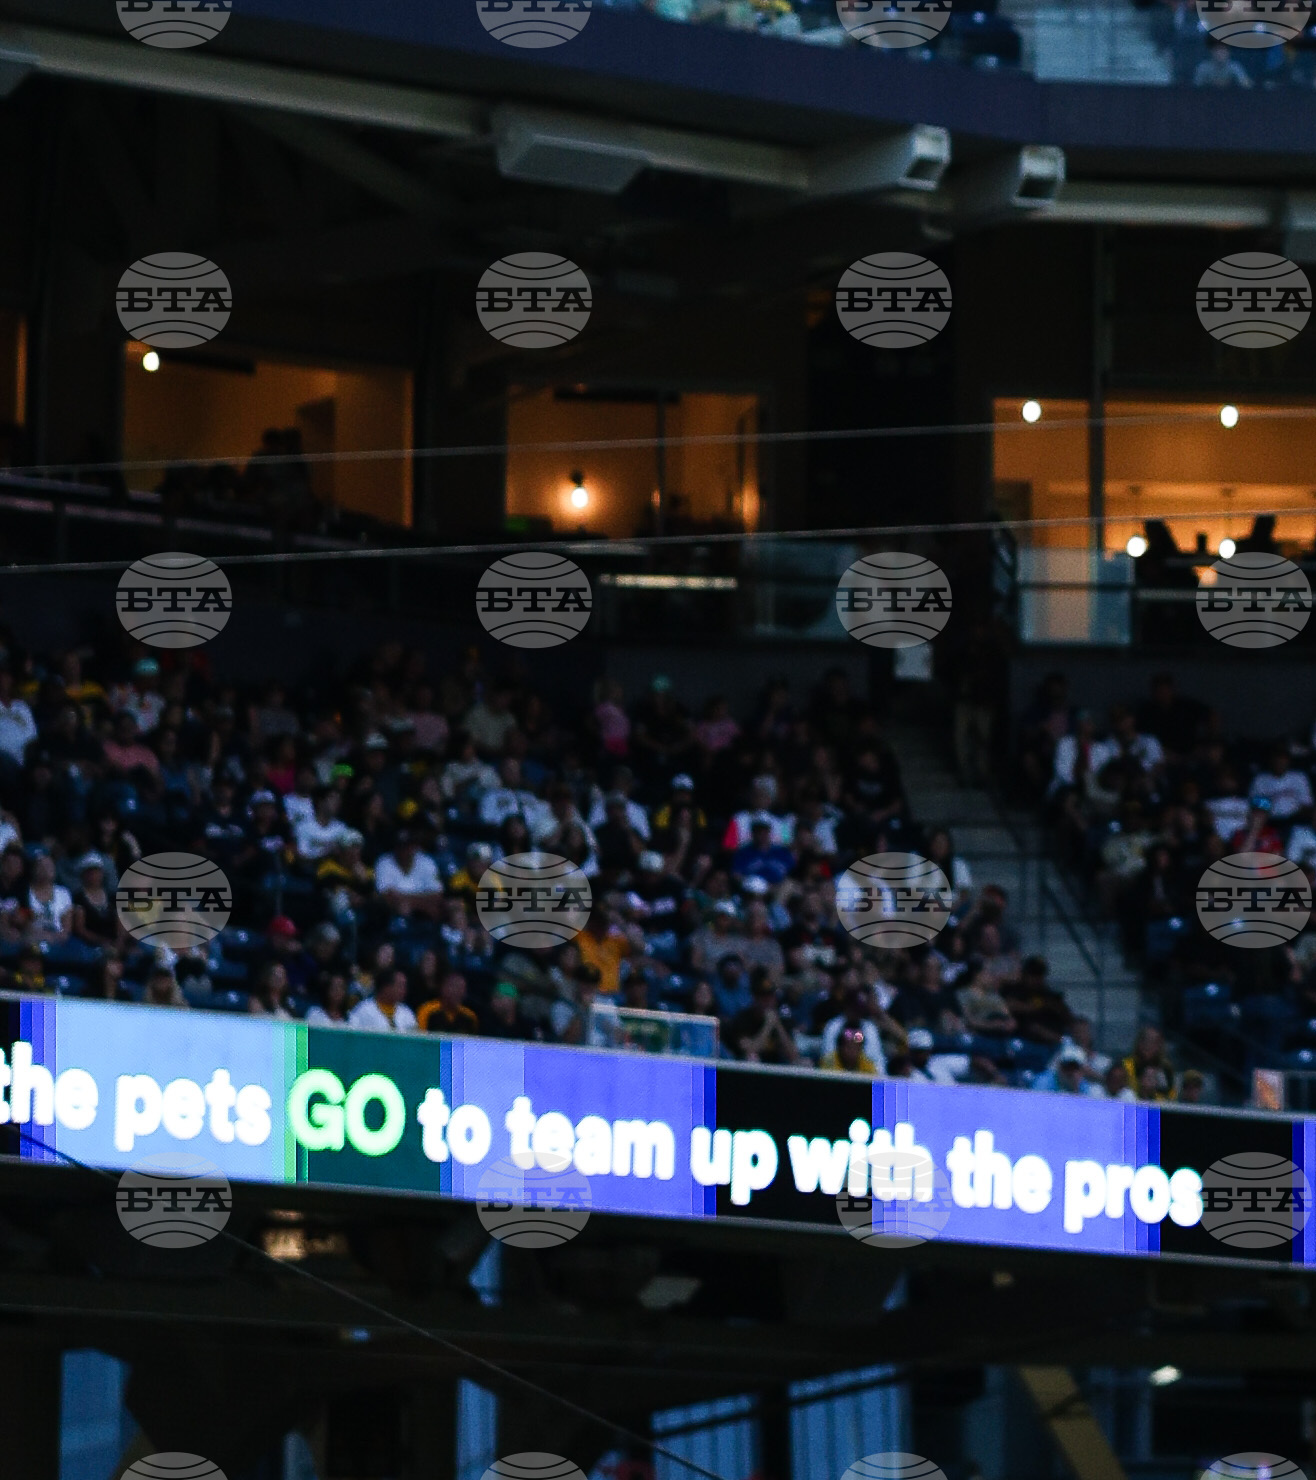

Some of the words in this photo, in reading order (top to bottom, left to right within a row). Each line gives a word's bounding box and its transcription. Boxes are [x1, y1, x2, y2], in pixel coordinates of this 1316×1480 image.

[114, 1068, 272, 1152] pets
[287, 1068, 406, 1156] GO
[417, 1087, 491, 1165] to
[505, 1096, 675, 1180] team
[690, 1126, 778, 1205] up
[788, 1117, 933, 1202] with
[946, 1129, 1052, 1214] the
[1064, 1159, 1203, 1234] pros
